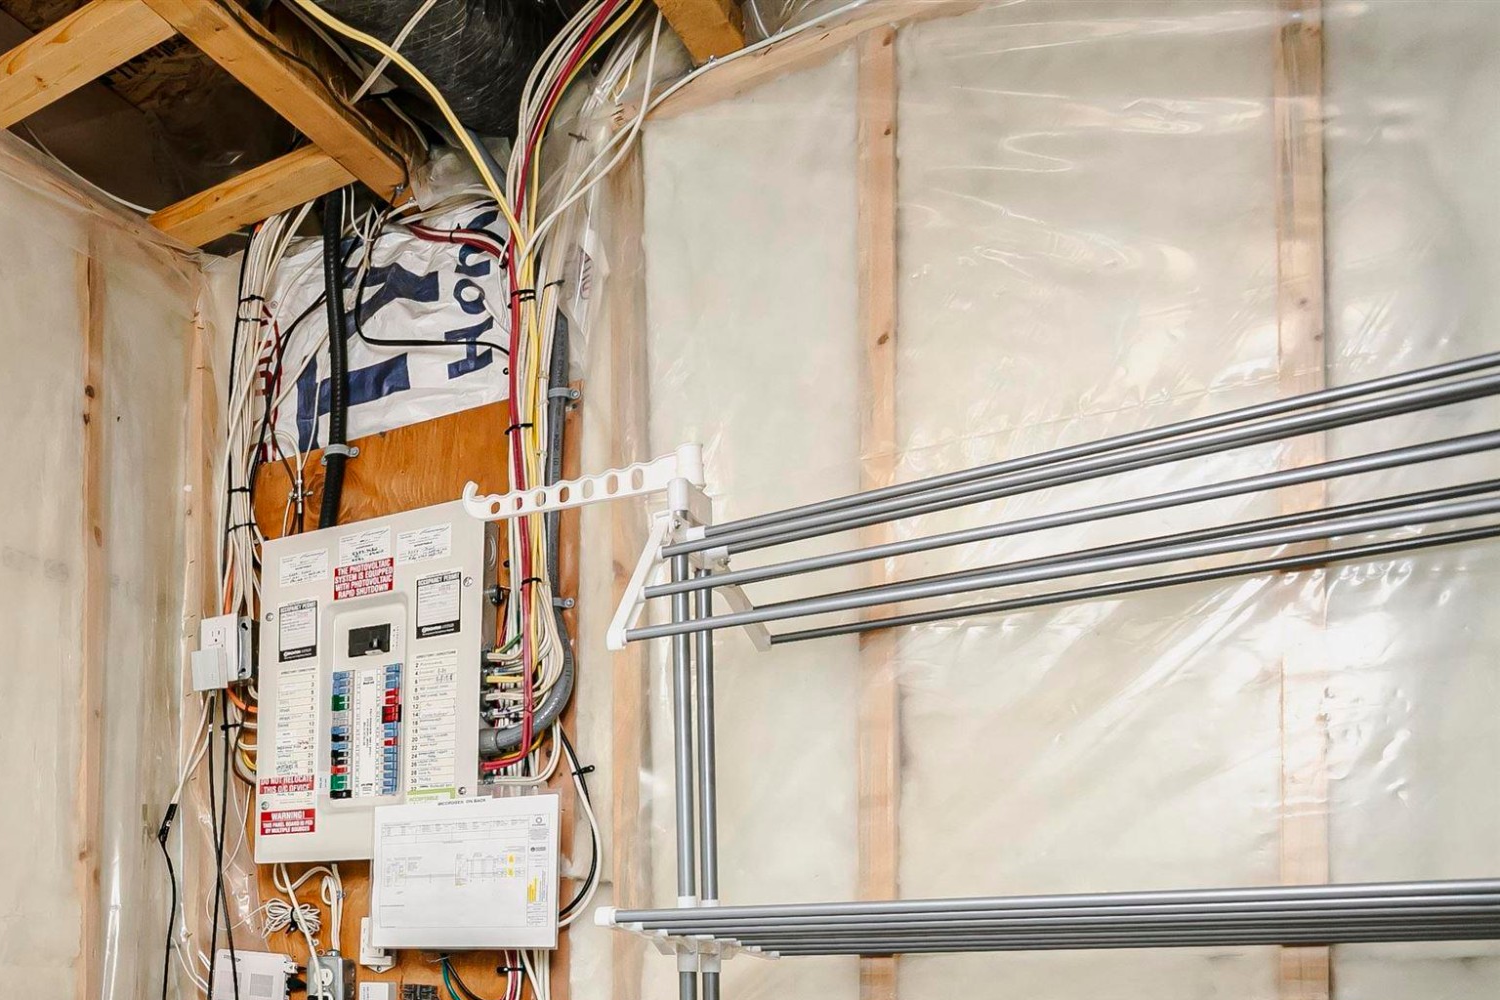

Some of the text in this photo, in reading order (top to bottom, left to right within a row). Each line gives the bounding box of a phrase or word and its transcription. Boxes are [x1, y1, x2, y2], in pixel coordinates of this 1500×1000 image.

[335, 566, 393, 583] SYSTEM IS EQUIPPED
[338, 560, 391, 575] THE PHOTOVOLTAIC
[335, 575, 393, 591] WITH PHOTOVOLTAIC
[339, 583, 388, 598] RAPID SHUTDOWN
[270, 776, 282, 785] NOT
[283, 775, 313, 784] RELOCATE
[264, 785, 276, 794] THIS
[289, 783, 310, 792] DEVICE
[271, 811, 305, 820] WARNING!
